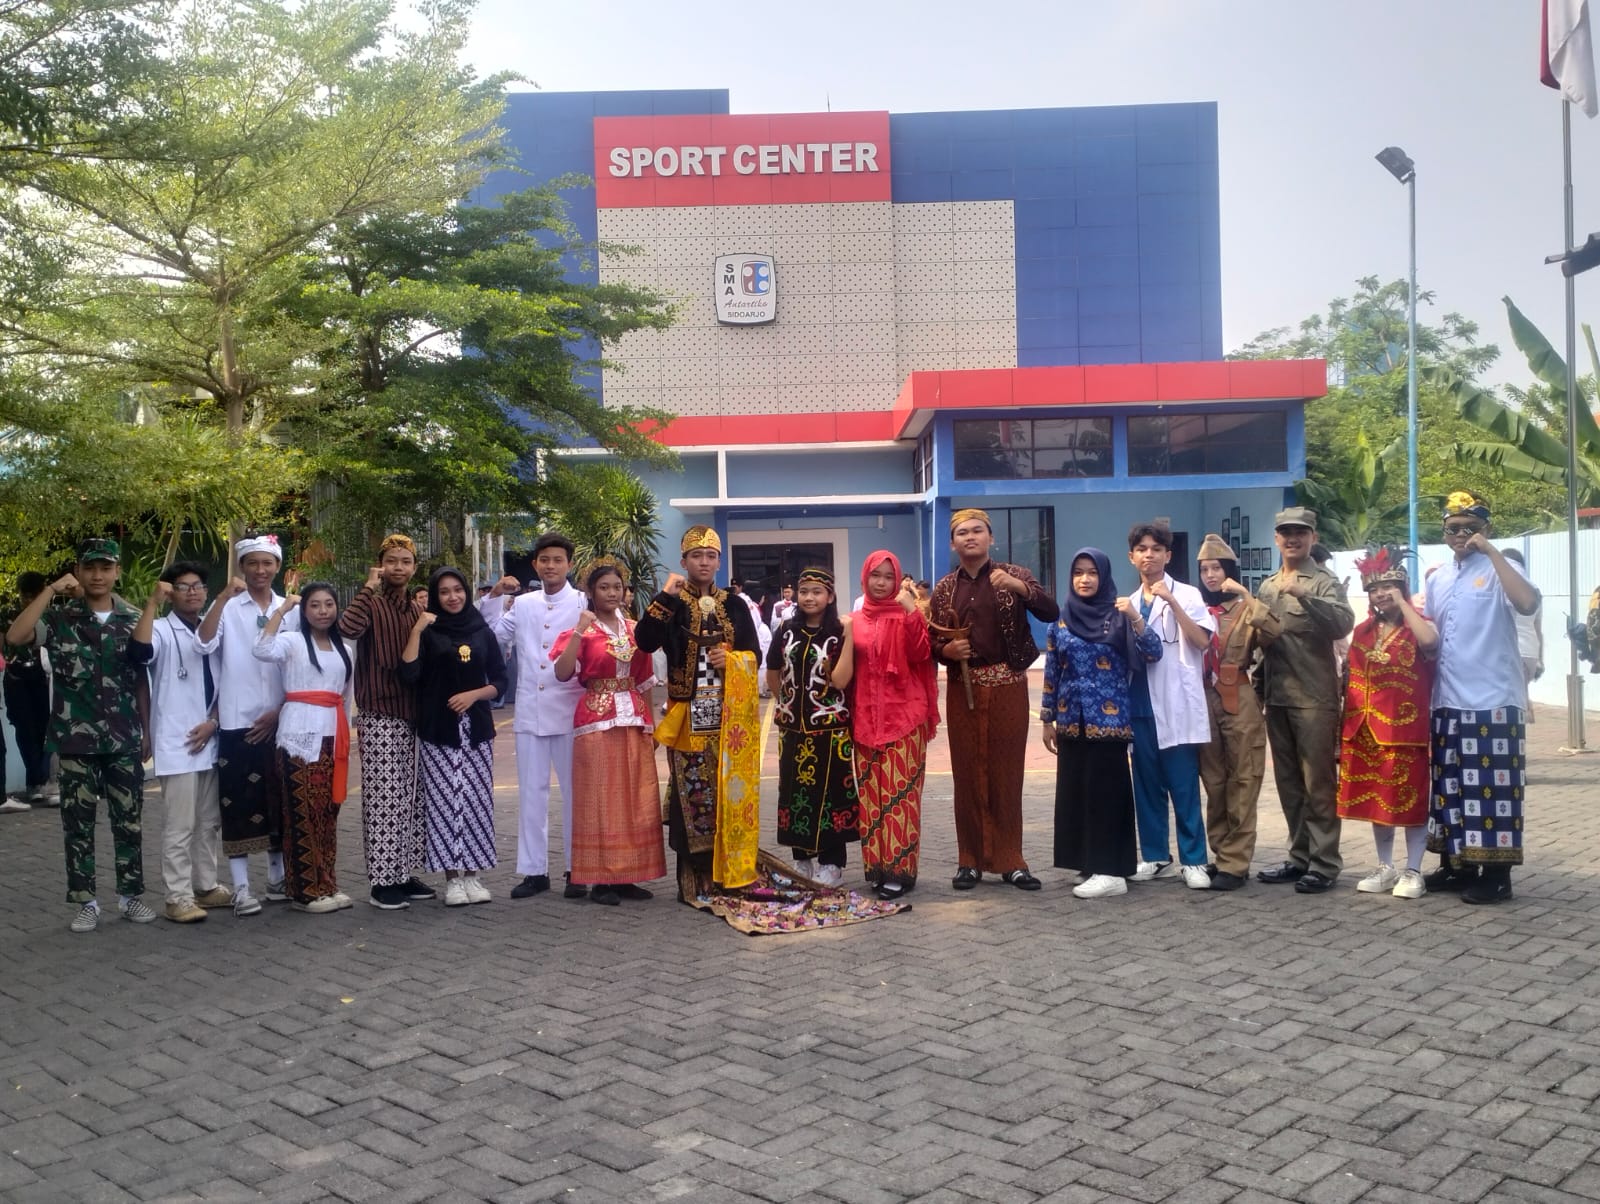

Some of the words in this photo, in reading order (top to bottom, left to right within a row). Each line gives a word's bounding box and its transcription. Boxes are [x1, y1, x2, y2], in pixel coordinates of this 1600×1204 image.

[608, 146, 727, 178] SPORT
[733, 142, 880, 175] CENTER
[723, 263, 735, 296] SMA
[723, 298, 769, 309] Antartika
